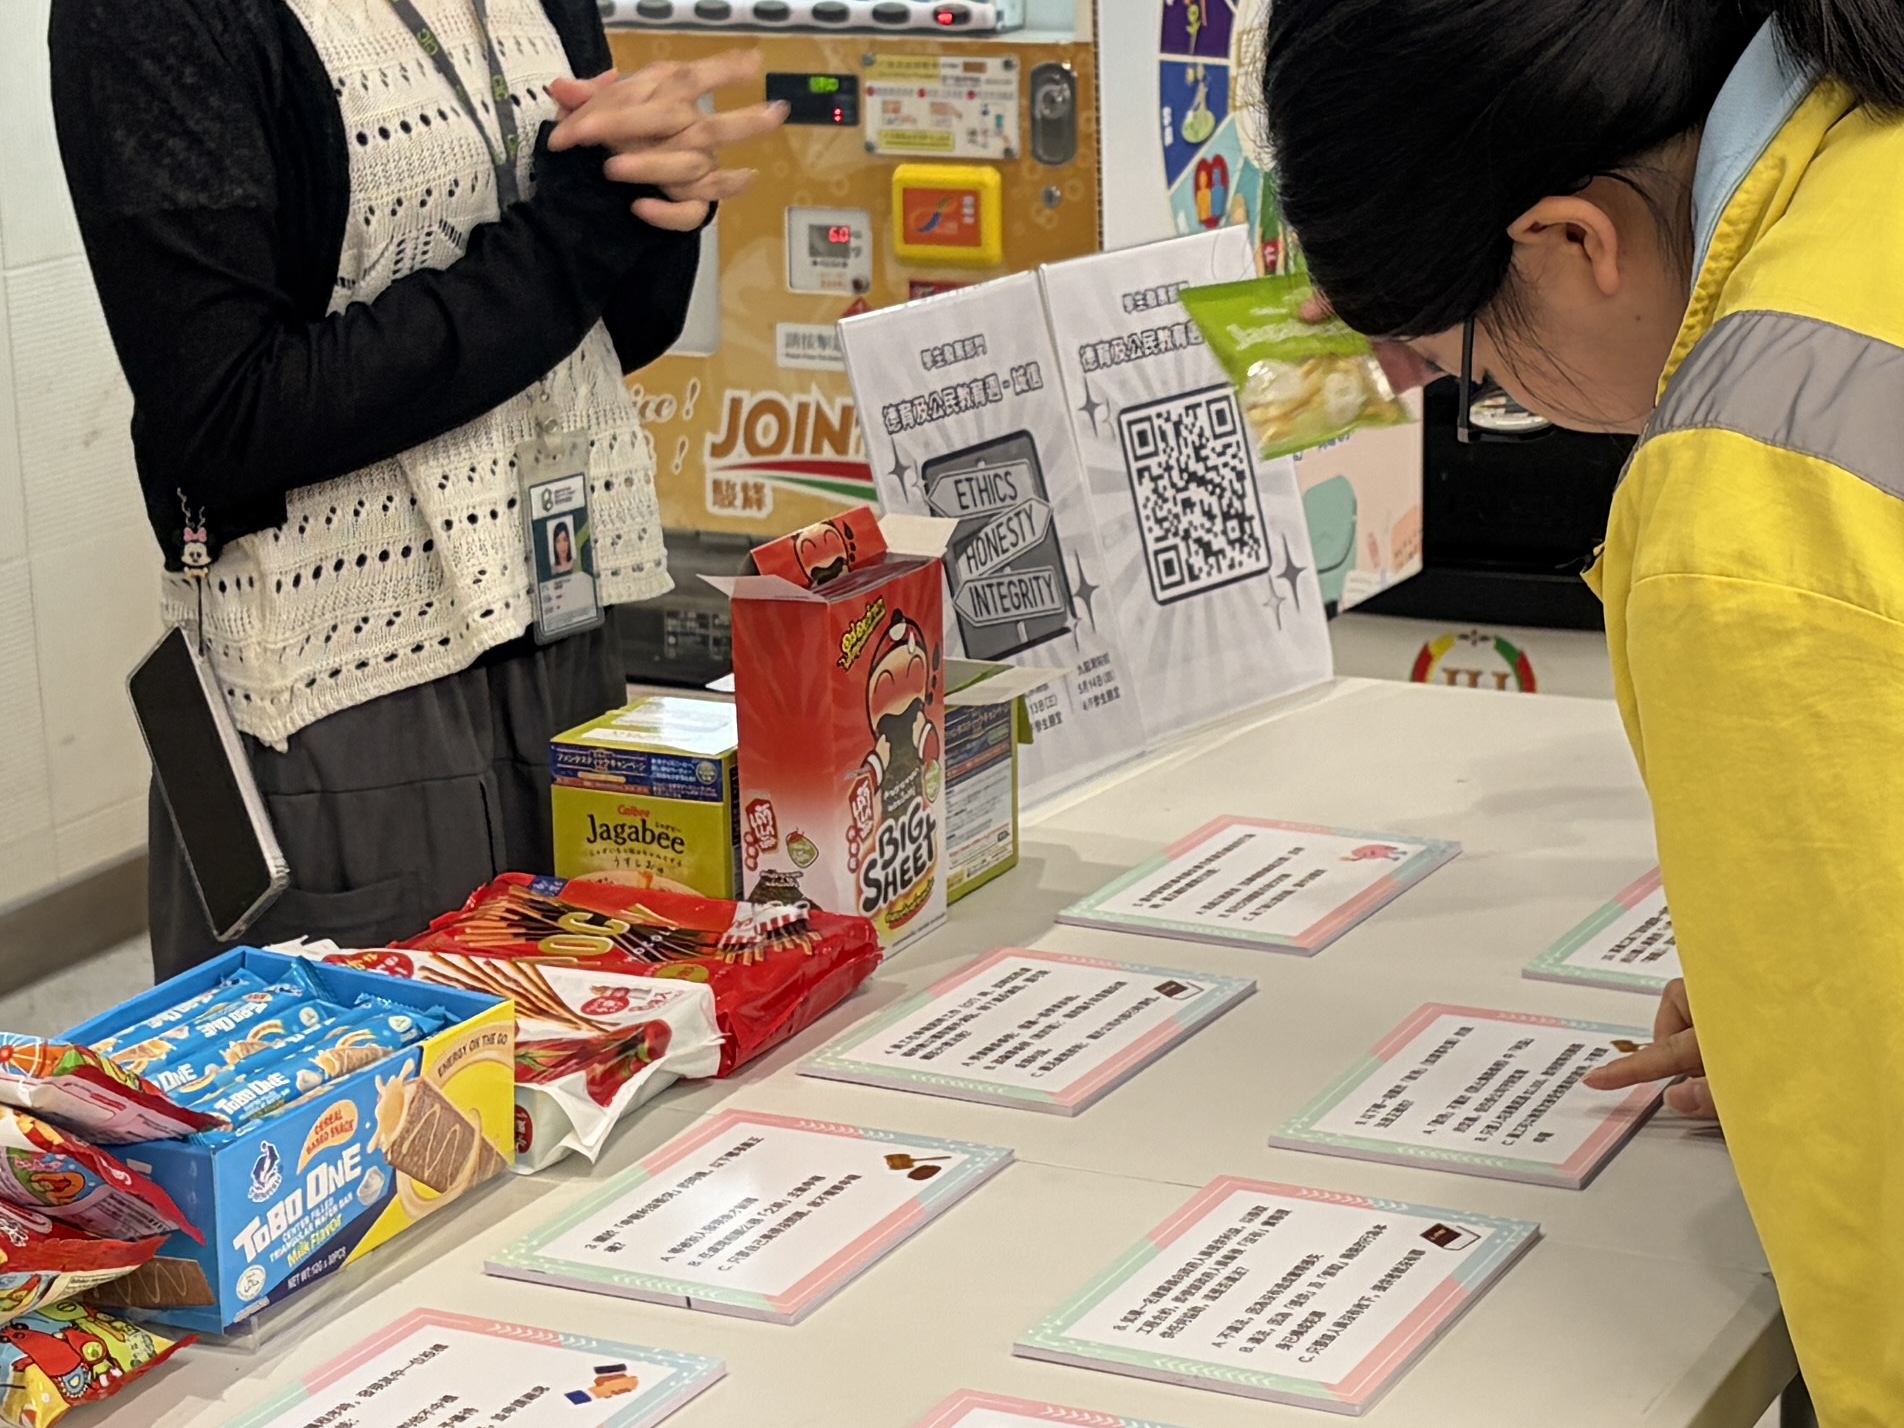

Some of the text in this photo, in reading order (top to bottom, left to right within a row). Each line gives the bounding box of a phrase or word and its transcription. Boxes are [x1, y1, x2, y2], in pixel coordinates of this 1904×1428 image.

[954, 470, 1018, 510] ETHICS
[964, 511, 1038, 576] HONESTY
[969, 576, 1056, 618] INTEGRITY
[585, 813, 686, 855] Jagabee
[878, 801, 925, 872] BIG
[862, 812, 937, 913] SHEET
[437, 1043, 468, 1078] ENERGY
[482, 1032, 496, 1047] THE
[306, 1119, 355, 1155] BASED SNACK
[314, 1108, 343, 1136] CEREAL
